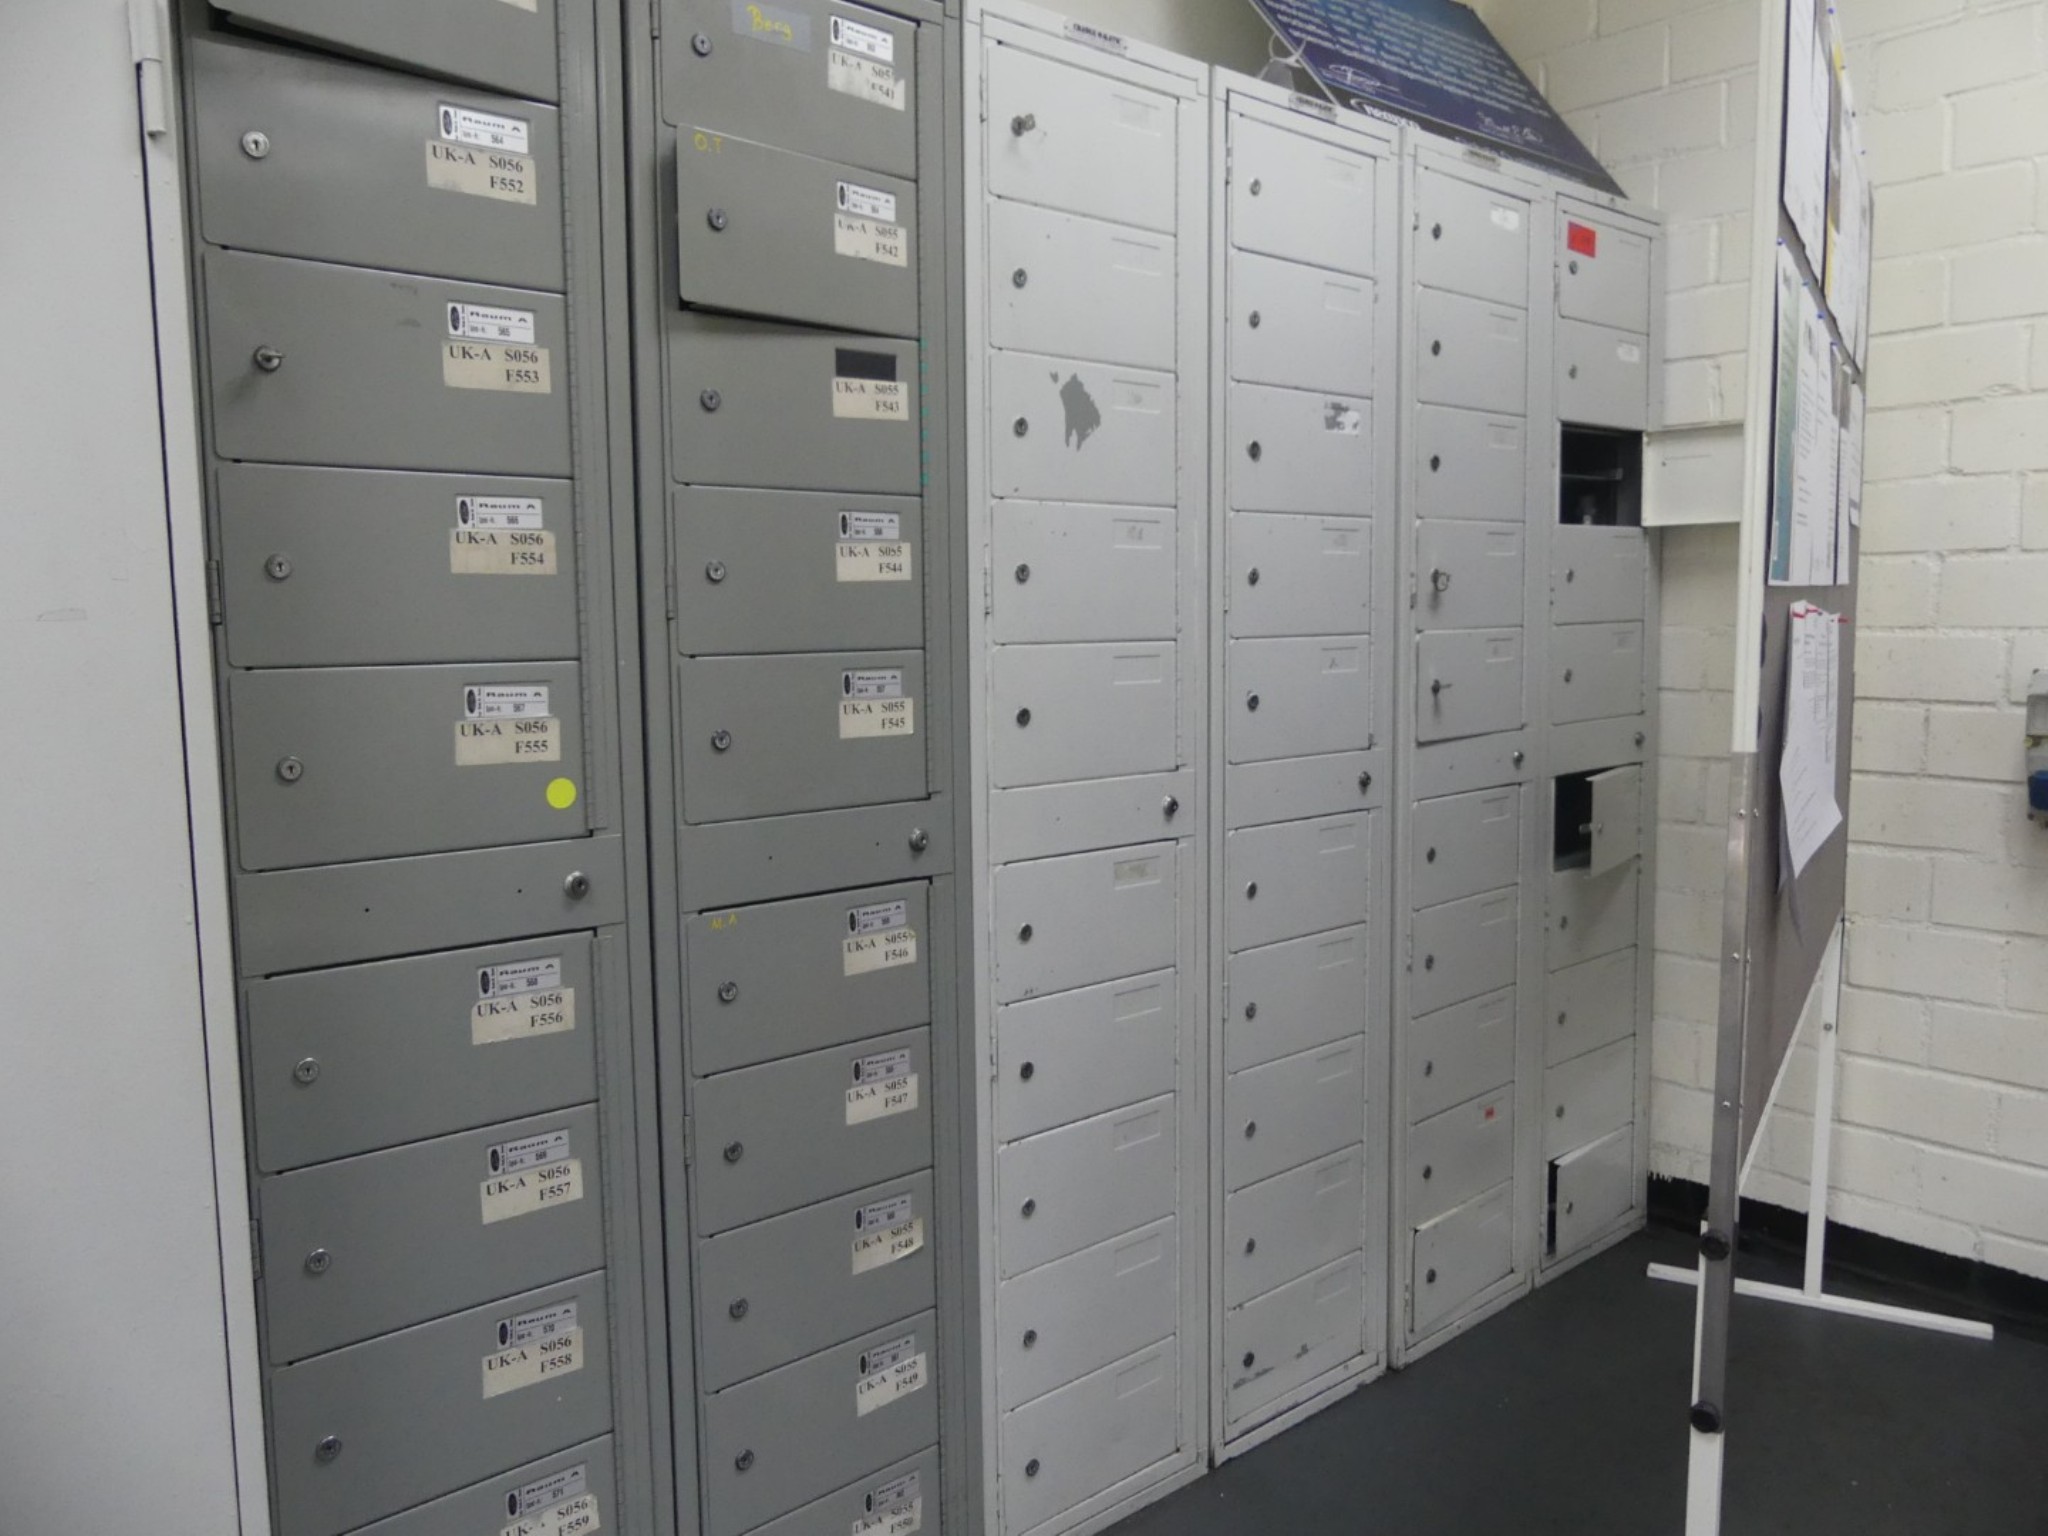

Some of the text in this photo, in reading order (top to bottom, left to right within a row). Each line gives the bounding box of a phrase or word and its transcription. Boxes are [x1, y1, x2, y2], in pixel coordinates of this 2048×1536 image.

[431, 144, 524, 173] UK-A S056
[489, 175, 524, 194] F552
[449, 344, 539, 364] UK-A S056
[505, 368, 540, 383] F553
[834, 380, 866, 395] UK-A
[455, 530, 544, 546] UK-A S056
[510, 551, 545, 566] F554
[839, 545, 870, 558] UK-A
[843, 703, 873, 716] UK-A
[460, 721, 549, 737] UK-A S056
[514, 739, 549, 754] F555
[846, 939, 877, 953] UK-A
[476, 993, 563, 1018] UK-A S056
[530, 1011, 564, 1028] F556
[847, 1086, 877, 1103] UK-A
[485, 1164, 571, 1197] UK-A S056
[539, 1181, 571, 1201] F557
[487, 1336, 573, 1371] UK-A S056
[540, 1352, 573, 1374] F558
[556, 1499, 589, 1521] S056
